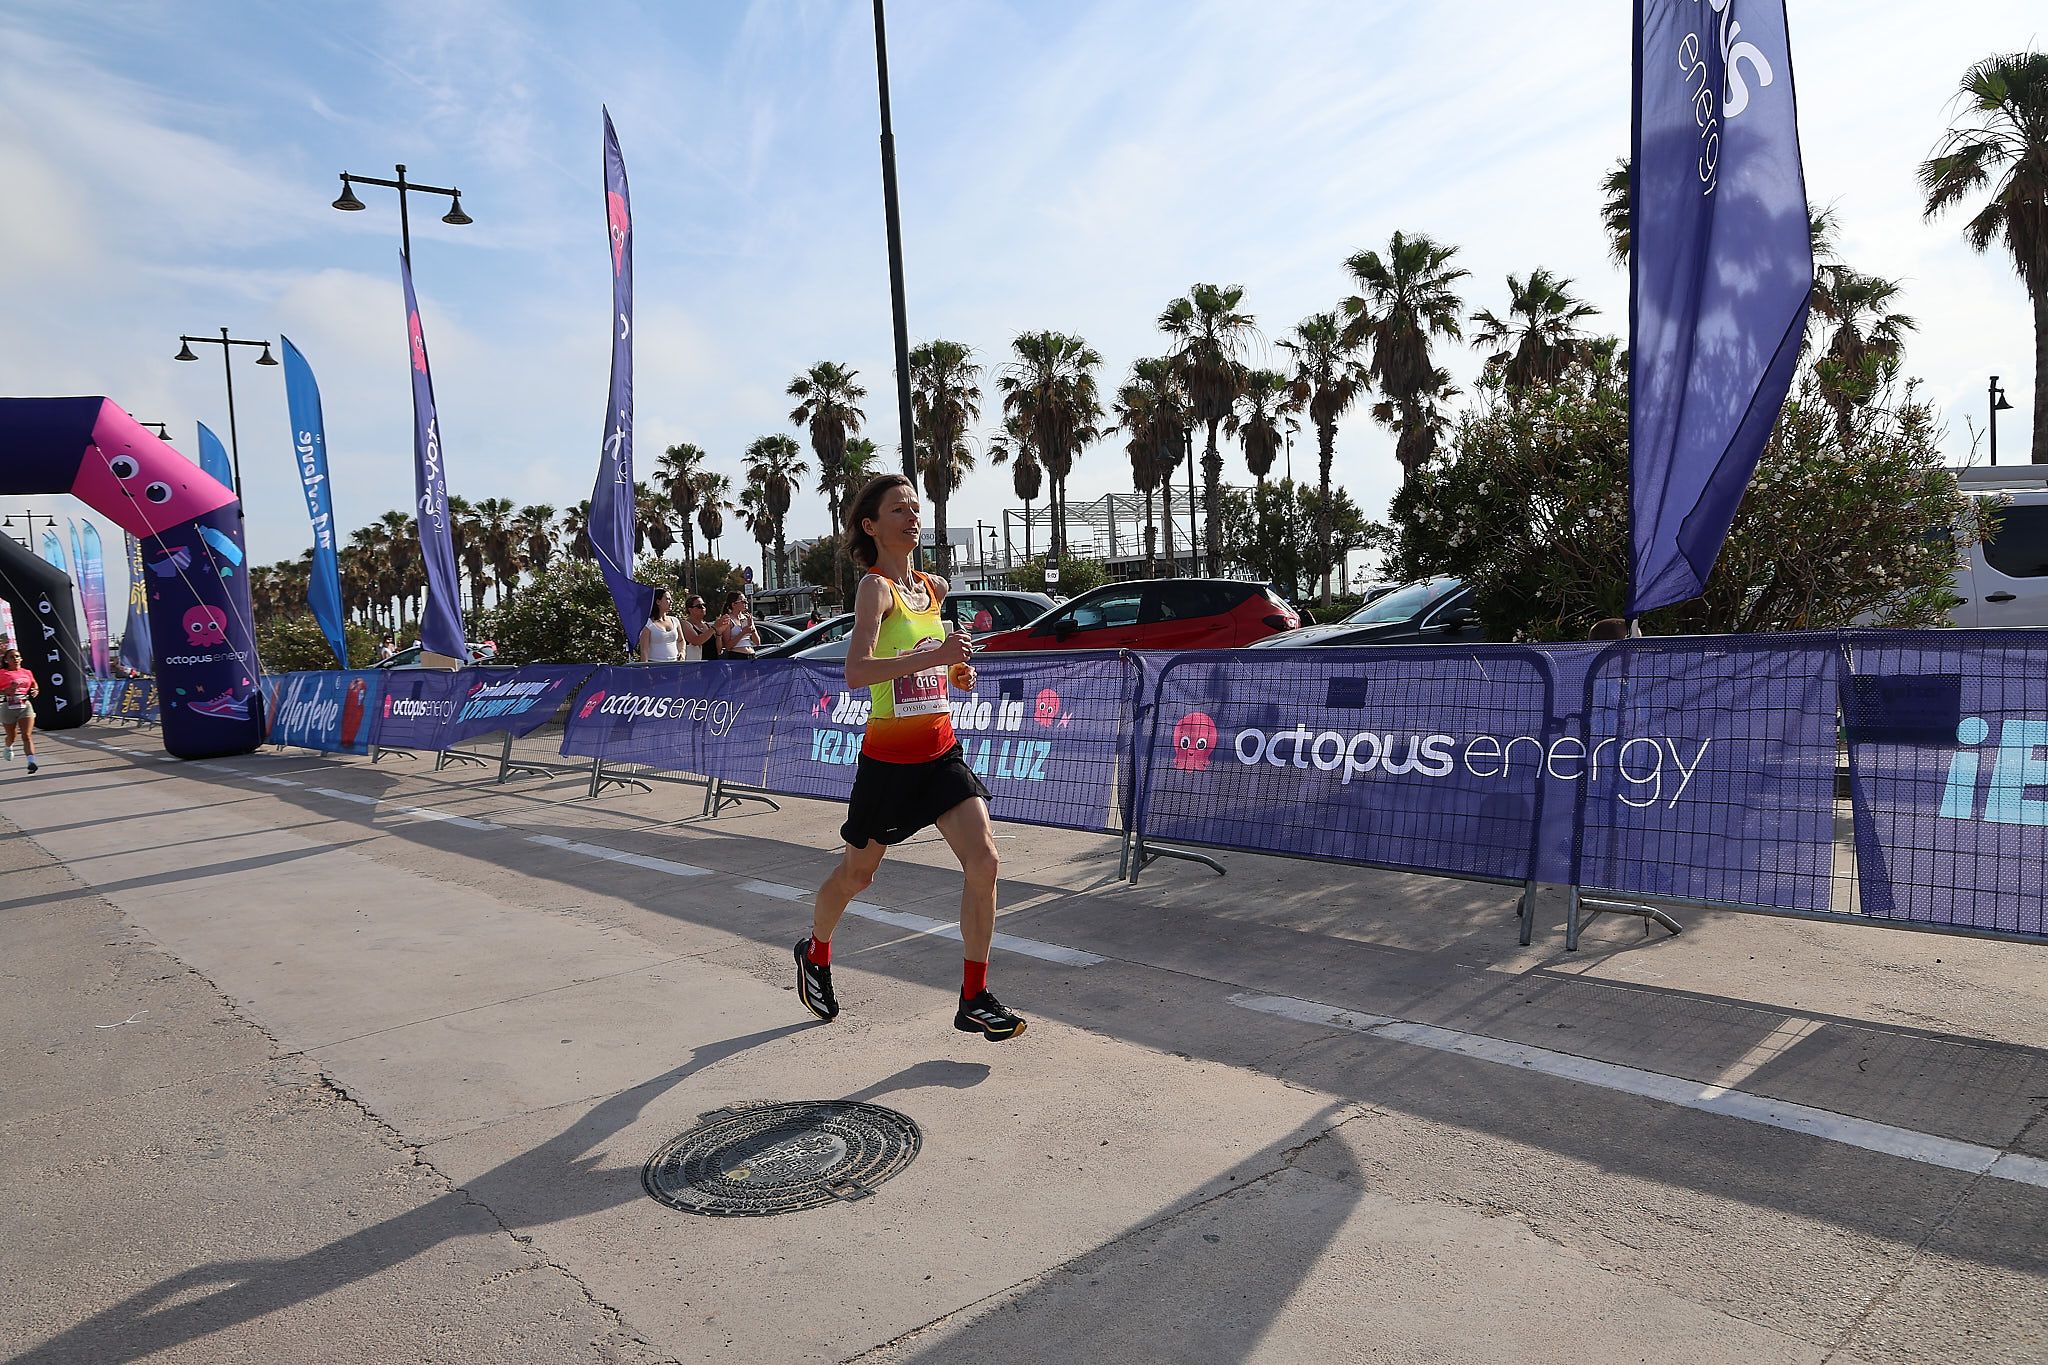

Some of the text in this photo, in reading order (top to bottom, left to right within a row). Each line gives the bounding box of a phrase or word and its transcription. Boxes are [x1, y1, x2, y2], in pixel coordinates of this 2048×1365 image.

[38, 600, 68, 712] VOLVO
[166, 650, 248, 666] octopus energy
[278, 675, 338, 745] Marlene
[393, 697, 458, 725] octopus energy
[600, 692, 744, 737] octopus energy
[832, 692, 1024, 732] Has ado la
[902, 704, 927, 712] OYSHO
[996, 740, 1052, 782] LUZ
[1234, 723, 1711, 809] octopus energy
